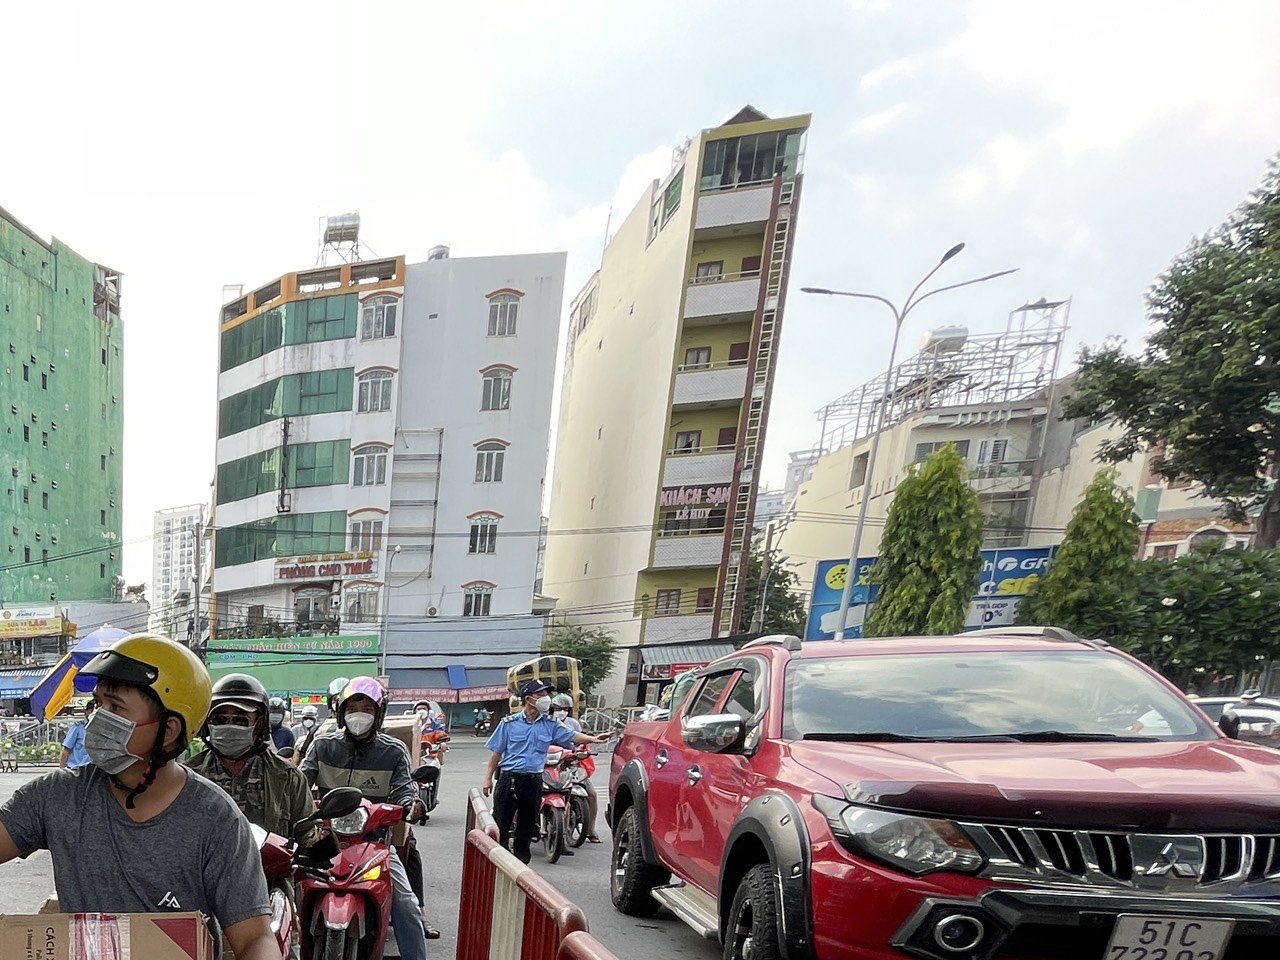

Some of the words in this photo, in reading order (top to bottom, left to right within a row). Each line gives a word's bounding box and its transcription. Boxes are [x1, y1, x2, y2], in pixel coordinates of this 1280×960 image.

[660, 486, 702, 506] KHÁCH
[705, 486, 731, 507] SẠN
[279, 563, 315, 579] PHÒNG
[318, 563, 341, 577] CHO
[344, 558, 374, 575] THUÊ
[347, 640, 373, 648] 1990
[45, 926, 57, 955] CÁCH
[1139, 920, 1202, 946] 51C
